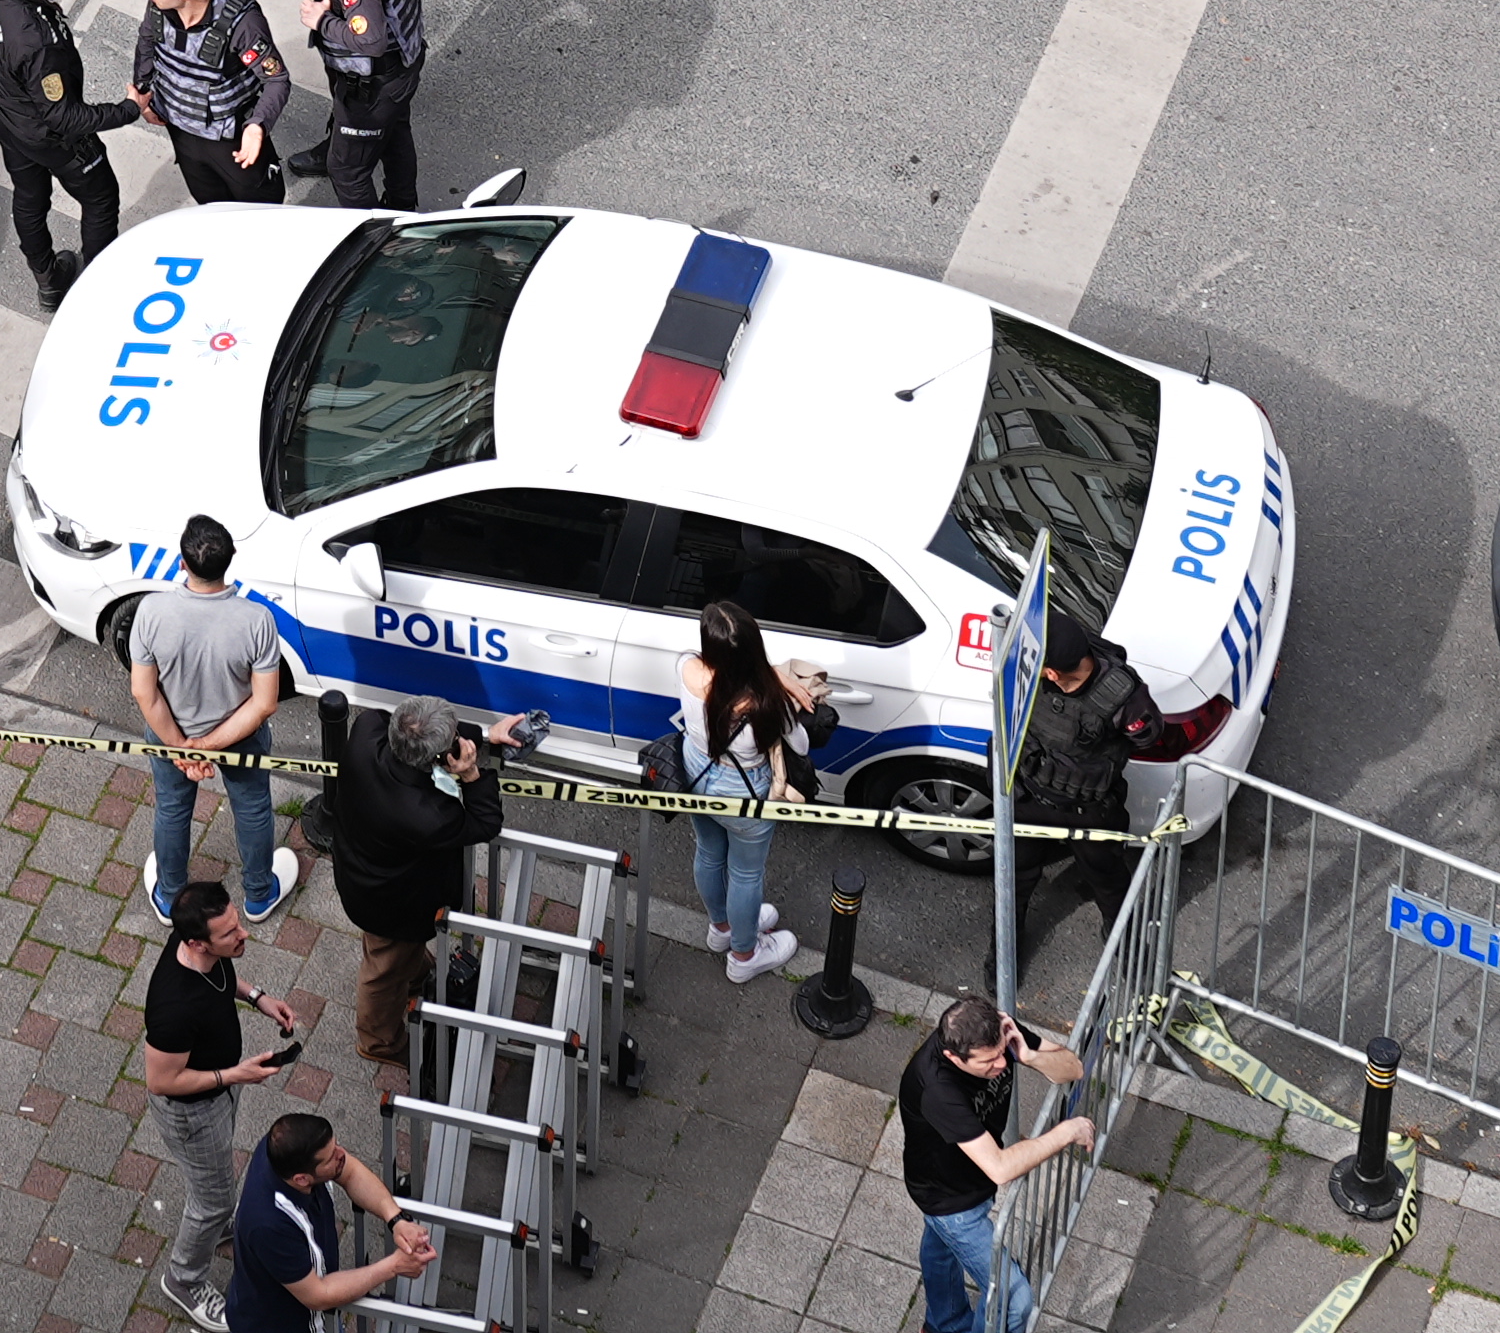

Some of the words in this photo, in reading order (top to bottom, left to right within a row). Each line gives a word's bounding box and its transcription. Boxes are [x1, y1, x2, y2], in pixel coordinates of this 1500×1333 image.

[98, 256, 203, 427] POLİS
[1172, 469, 1241, 585] POLİS
[375, 605, 509, 662] POLİS
[967, 618, 993, 648] 11
